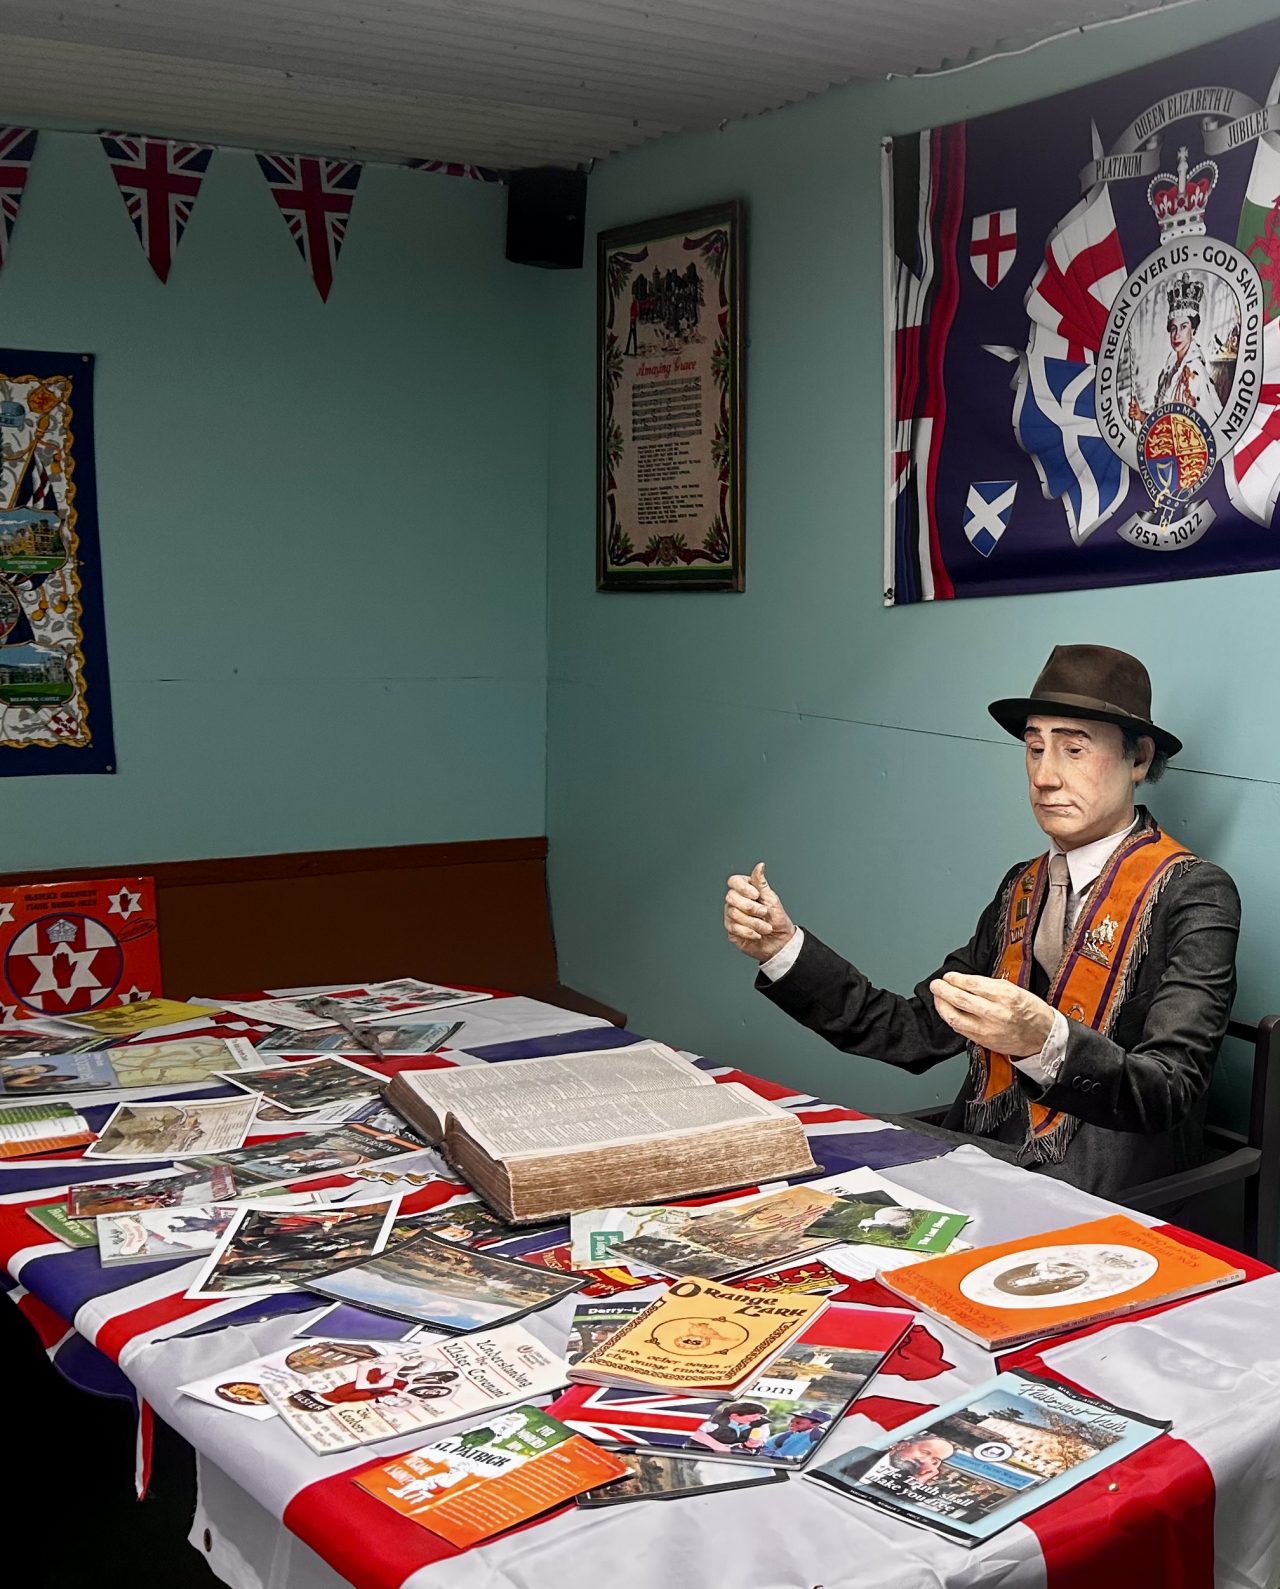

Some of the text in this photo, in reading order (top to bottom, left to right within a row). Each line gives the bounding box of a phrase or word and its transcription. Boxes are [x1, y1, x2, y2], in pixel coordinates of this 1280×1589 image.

[1133, 90, 1234, 140] QUEEN ELIZABETH II
[1227, 110, 1269, 148] JUBILEE
[1095, 153, 1142, 180] PLATINUM
[1170, 245, 1189, 265] US
[1202, 246, 1238, 273] GOD
[1129, 257, 1168, 298] OVER
[1236, 267, 1258, 312] SAVE
[1103, 299, 1132, 360] REIGN
[1243, 313, 1258, 363] OUR
[636, 356, 697, 378] Amazing Grace
[1100, 368, 1112, 395] TO
[1100, 397, 1127, 449] LONG
[1221, 369, 1256, 441] QUEEN
[1137, 423, 1150, 452] SOIT
[1156, 405, 1175, 417] QUI
[1182, 406, 1201, 426] MAL
[1128, 522, 1160, 547] 1952
[1170, 512, 1203, 545] 2022
[442, 1343, 511, 1398] Ulster Covenant
[476, 1340, 533, 1387] Understanding
[647, 1354, 679, 1364] other
[294, 1394, 325, 1412] ULSTER
[450, 1446, 513, 1467] PATRICK
[866, 1474, 901, 1491] make
[898, 1486, 926, 1504] you
[878, 1464, 975, 1507] The Truth shall
